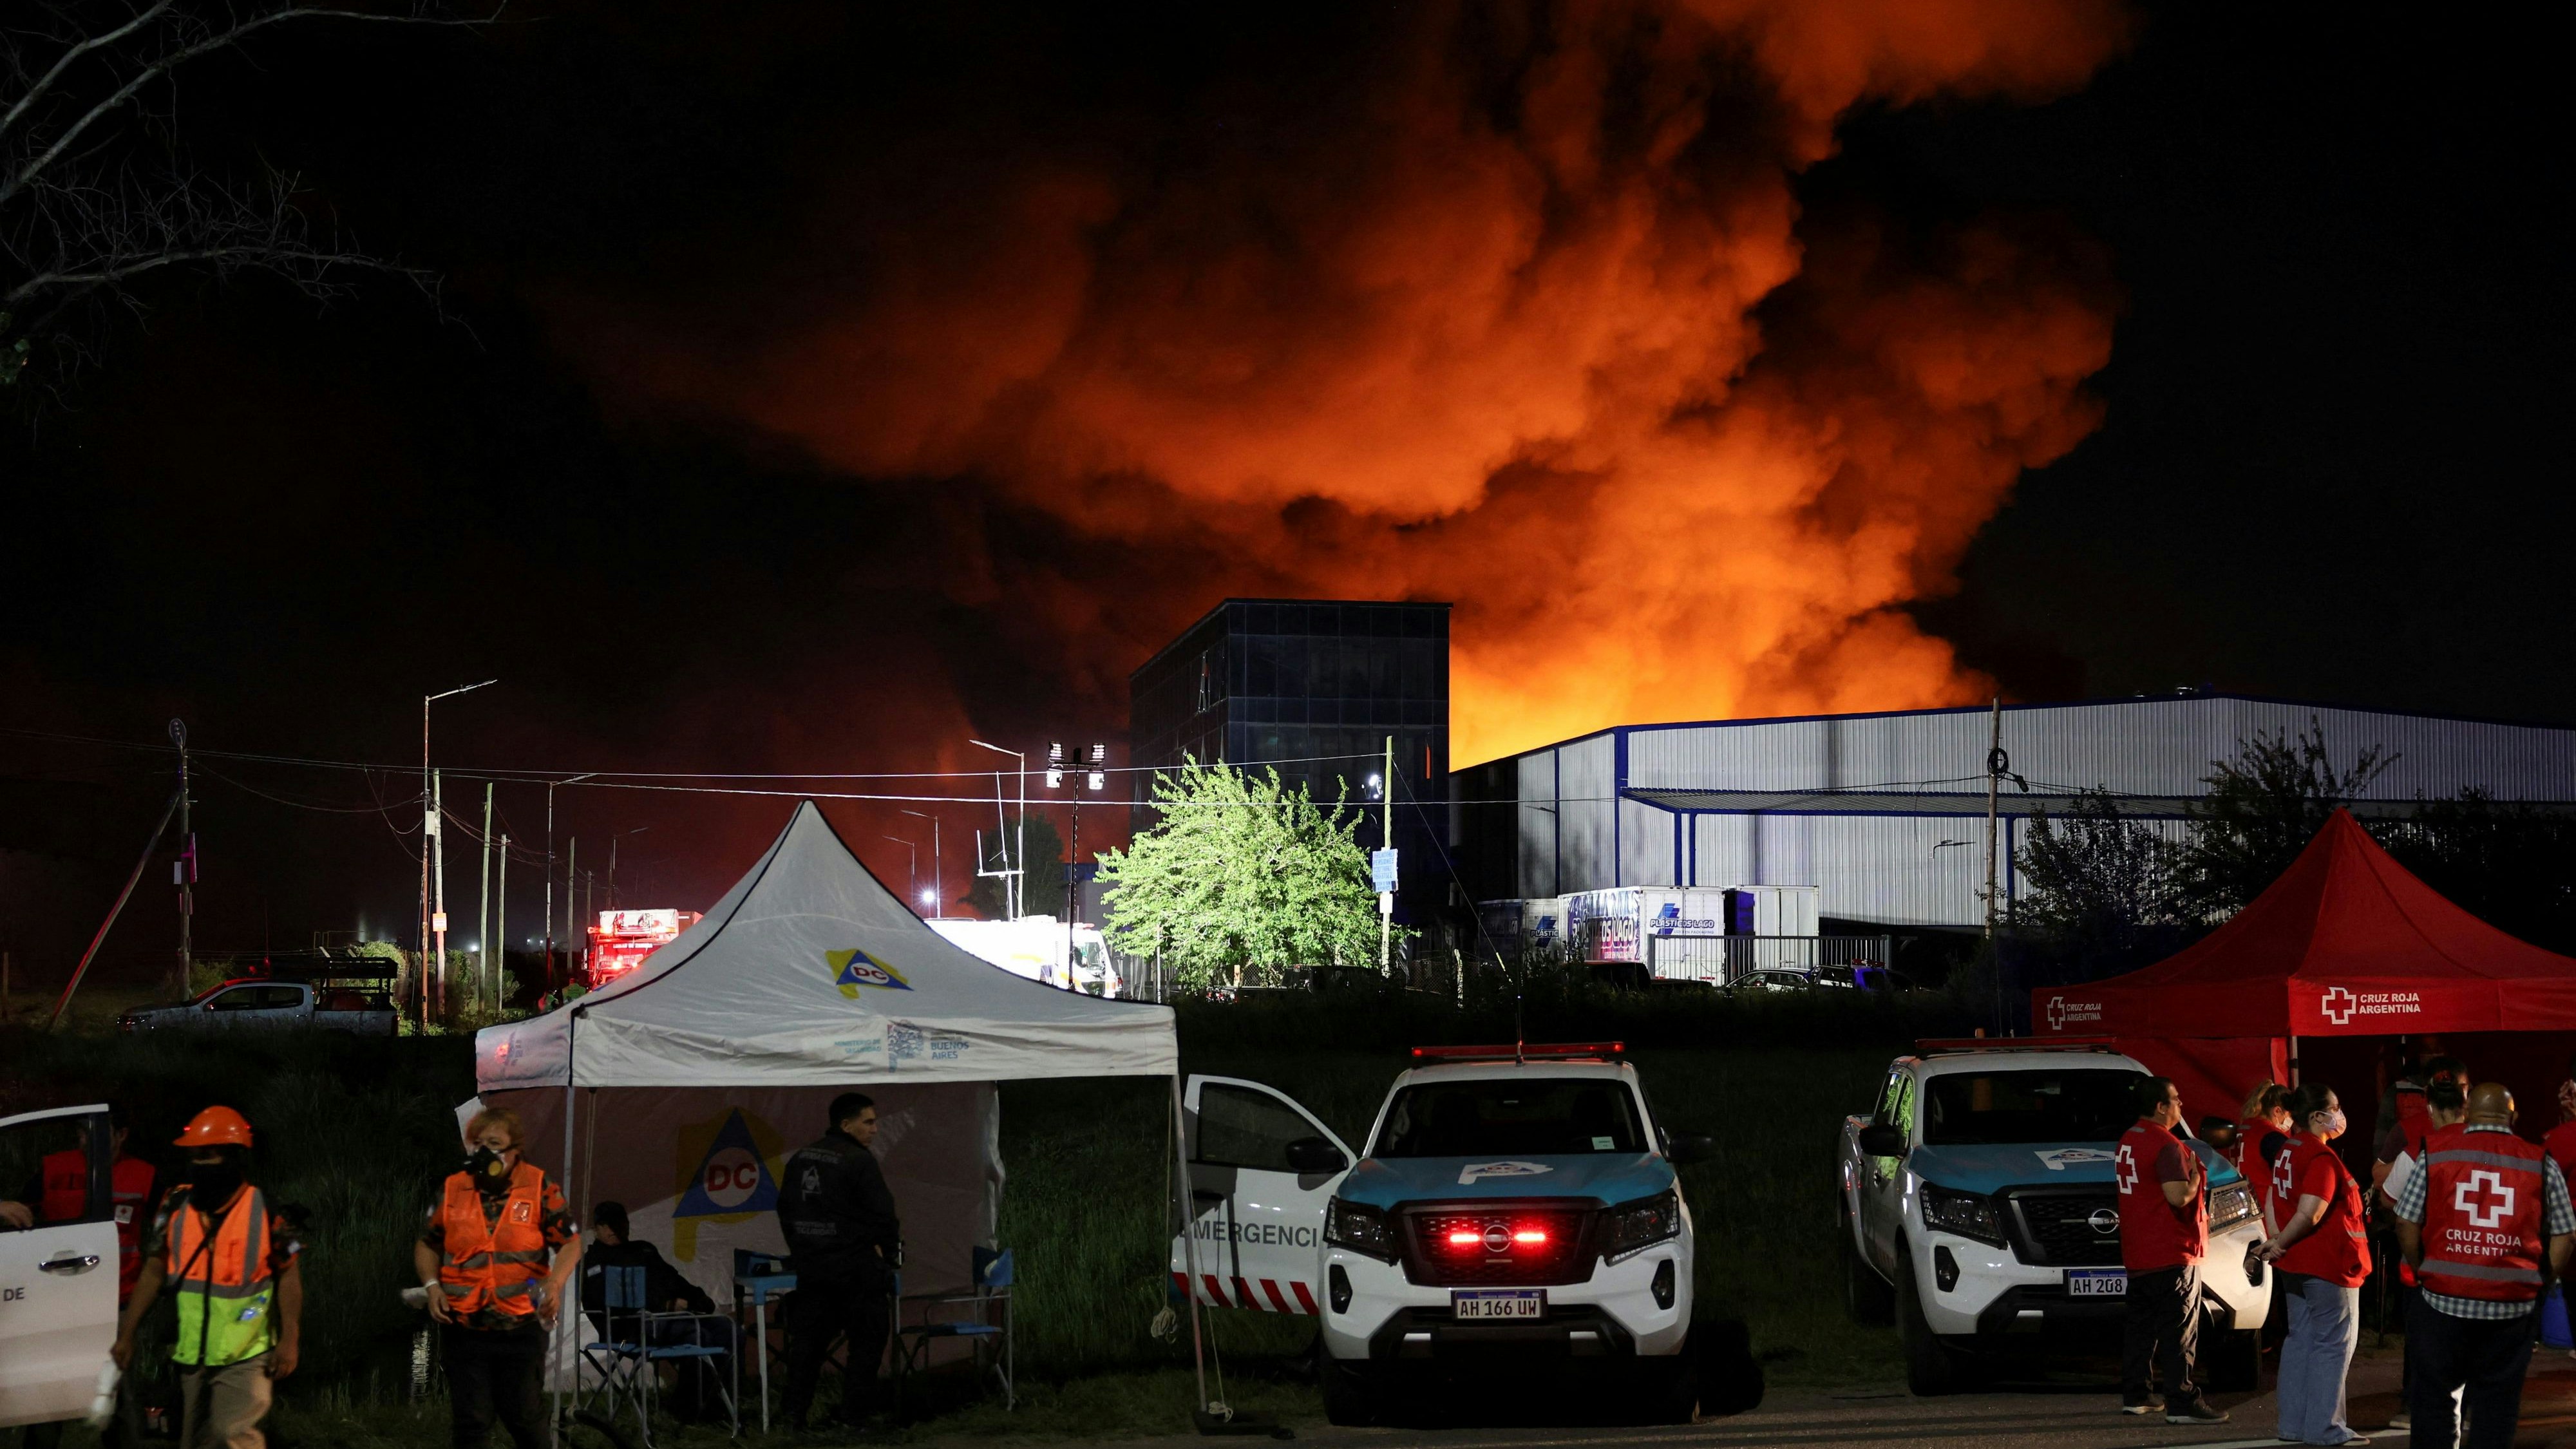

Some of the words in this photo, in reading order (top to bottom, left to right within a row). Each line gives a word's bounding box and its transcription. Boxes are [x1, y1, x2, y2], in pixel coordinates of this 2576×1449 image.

[1650, 916, 1692, 927] PLÁSTICOS
[1693, 920, 1714, 928] LAGO
[1613, 919, 1634, 943] LAGO
[853, 966, 887, 980] DC
[2360, 994, 2389, 1003] CRUZ
[2392, 993, 2420, 1002] ROJA
[2359, 1004, 2421, 1014] ARGENTINA
[2067, 1012, 2101, 1021] ARGENTINA
[931, 1041, 969, 1050] BUENOS
[932, 1051, 958, 1060] AIRES
[708, 1162, 757, 1191] DC
[1179, 1220, 1318, 1247] MERGENCI
[2446, 1229, 2481, 1242] CRUZ
[2486, 1233, 2521, 1247] ROJA
[2446, 1244, 2519, 1256] ARGENTI
[2074, 1279, 2091, 1293] AH
[2096, 1278, 2123, 1293] 208
[4, 1287, 25, 1301] DE
[1461, 1301, 1479, 1316] AH
[1484, 1301, 1512, 1316] 166
[1518, 1300, 1536, 1315] UW
